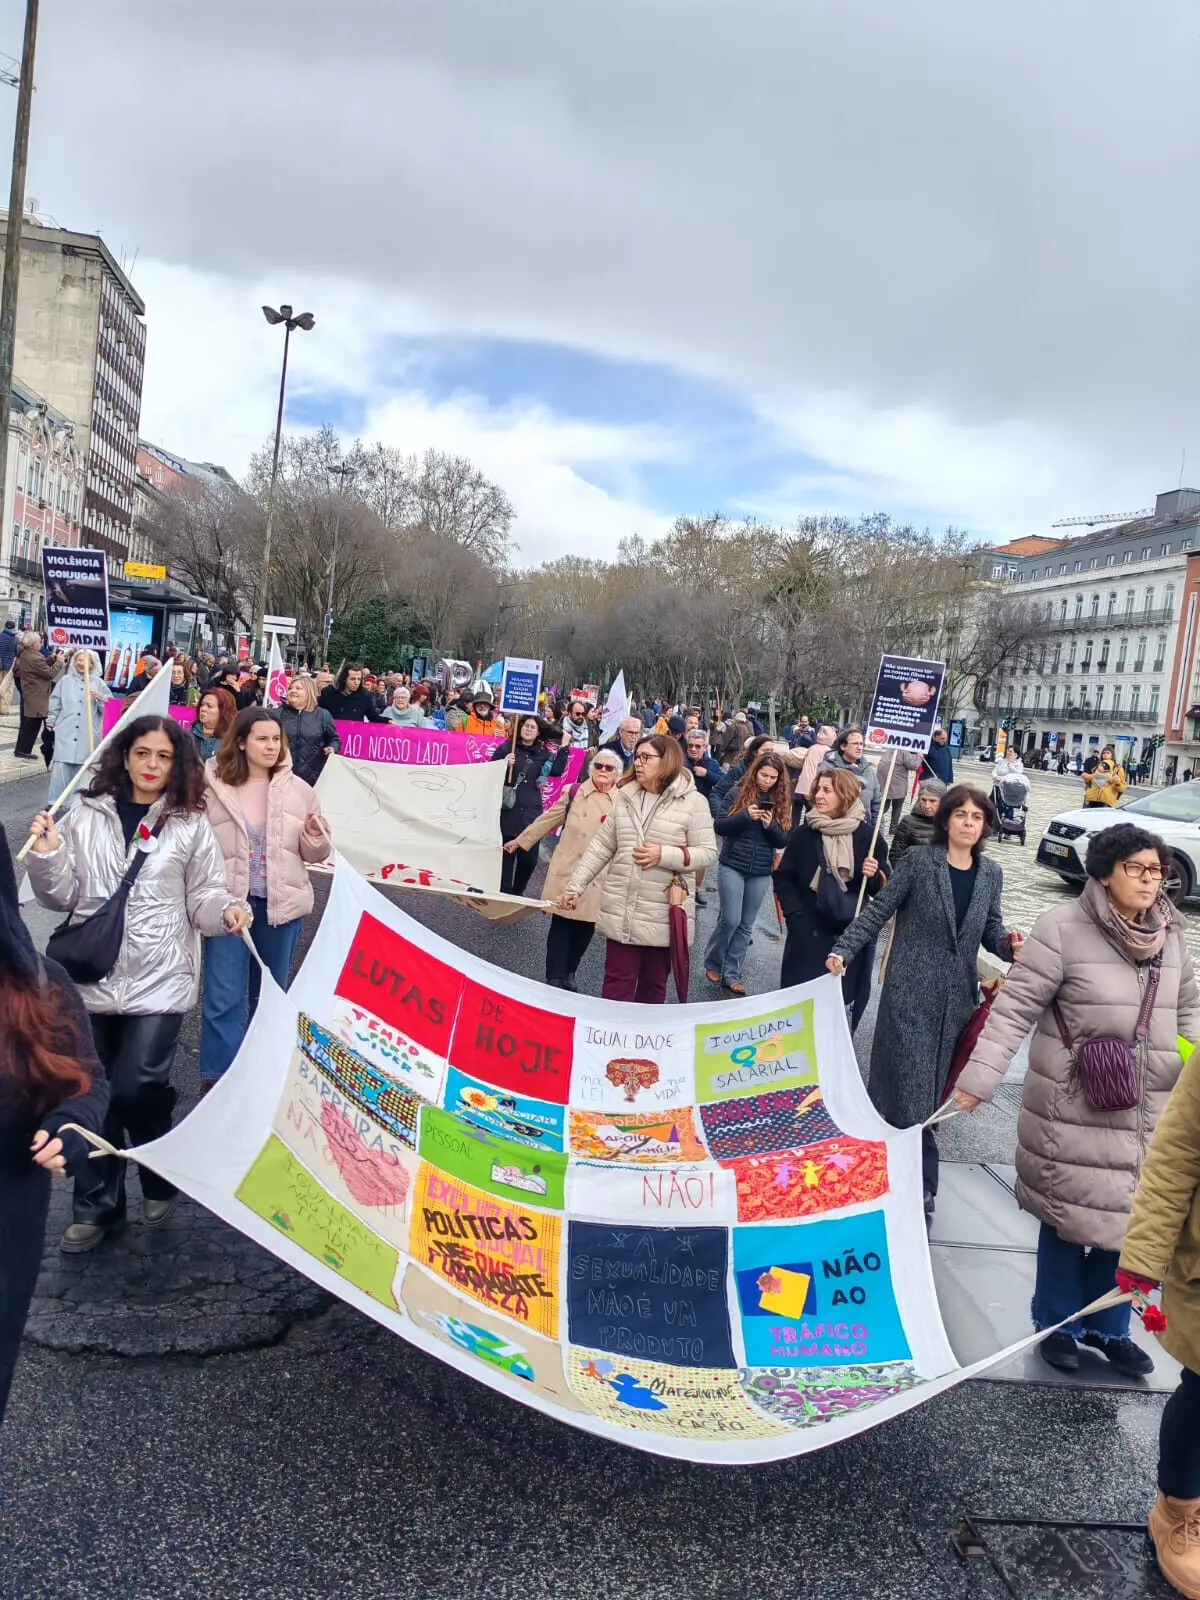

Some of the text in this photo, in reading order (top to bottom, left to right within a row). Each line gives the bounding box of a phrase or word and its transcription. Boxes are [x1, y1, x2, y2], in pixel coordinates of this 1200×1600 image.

[46, 555, 100, 568] VIOLÊNCIA
[48, 569, 101, 581] CONJUGAL
[50, 604, 105, 616] É VERGONHA
[54, 617, 102, 628] NACIONAL!
[69, 633, 107, 647] MDM
[344, 734, 449, 766] AO NOSSO LADO
[887, 734, 926, 750] MDM
[350, 949, 447, 1026] LUTAS
[480, 996, 504, 1023] DE
[352, 1008, 420, 1056] TEMPO
[585, 1025, 674, 1051] IGUALDADE
[355, 1031, 412, 1073] VIVER
[474, 1023, 562, 1075] HOJE
[716, 1056, 799, 1089] SALARIAL
[581, 1086, 604, 1102] LEI
[654, 1086, 682, 1101] VIDA
[298, 1058, 402, 1167] BARREIRAS
[425, 1122, 474, 1160] PESSOAL
[642, 1168, 715, 1210] NÃO!
[422, 1208, 538, 1241] POLÍTICAS
[571, 1253, 720, 1292] SEXUALIDADE
[821, 1248, 882, 1280] NÃO
[587, 1282, 635, 1318] NÃO
[663, 1299, 698, 1328] UM
[831, 1288, 867, 1306] AO
[599, 1324, 705, 1363] PRODUTO
[769, 1321, 868, 1344] TRÁFICO
[769, 1342, 868, 1358] HUMANO
